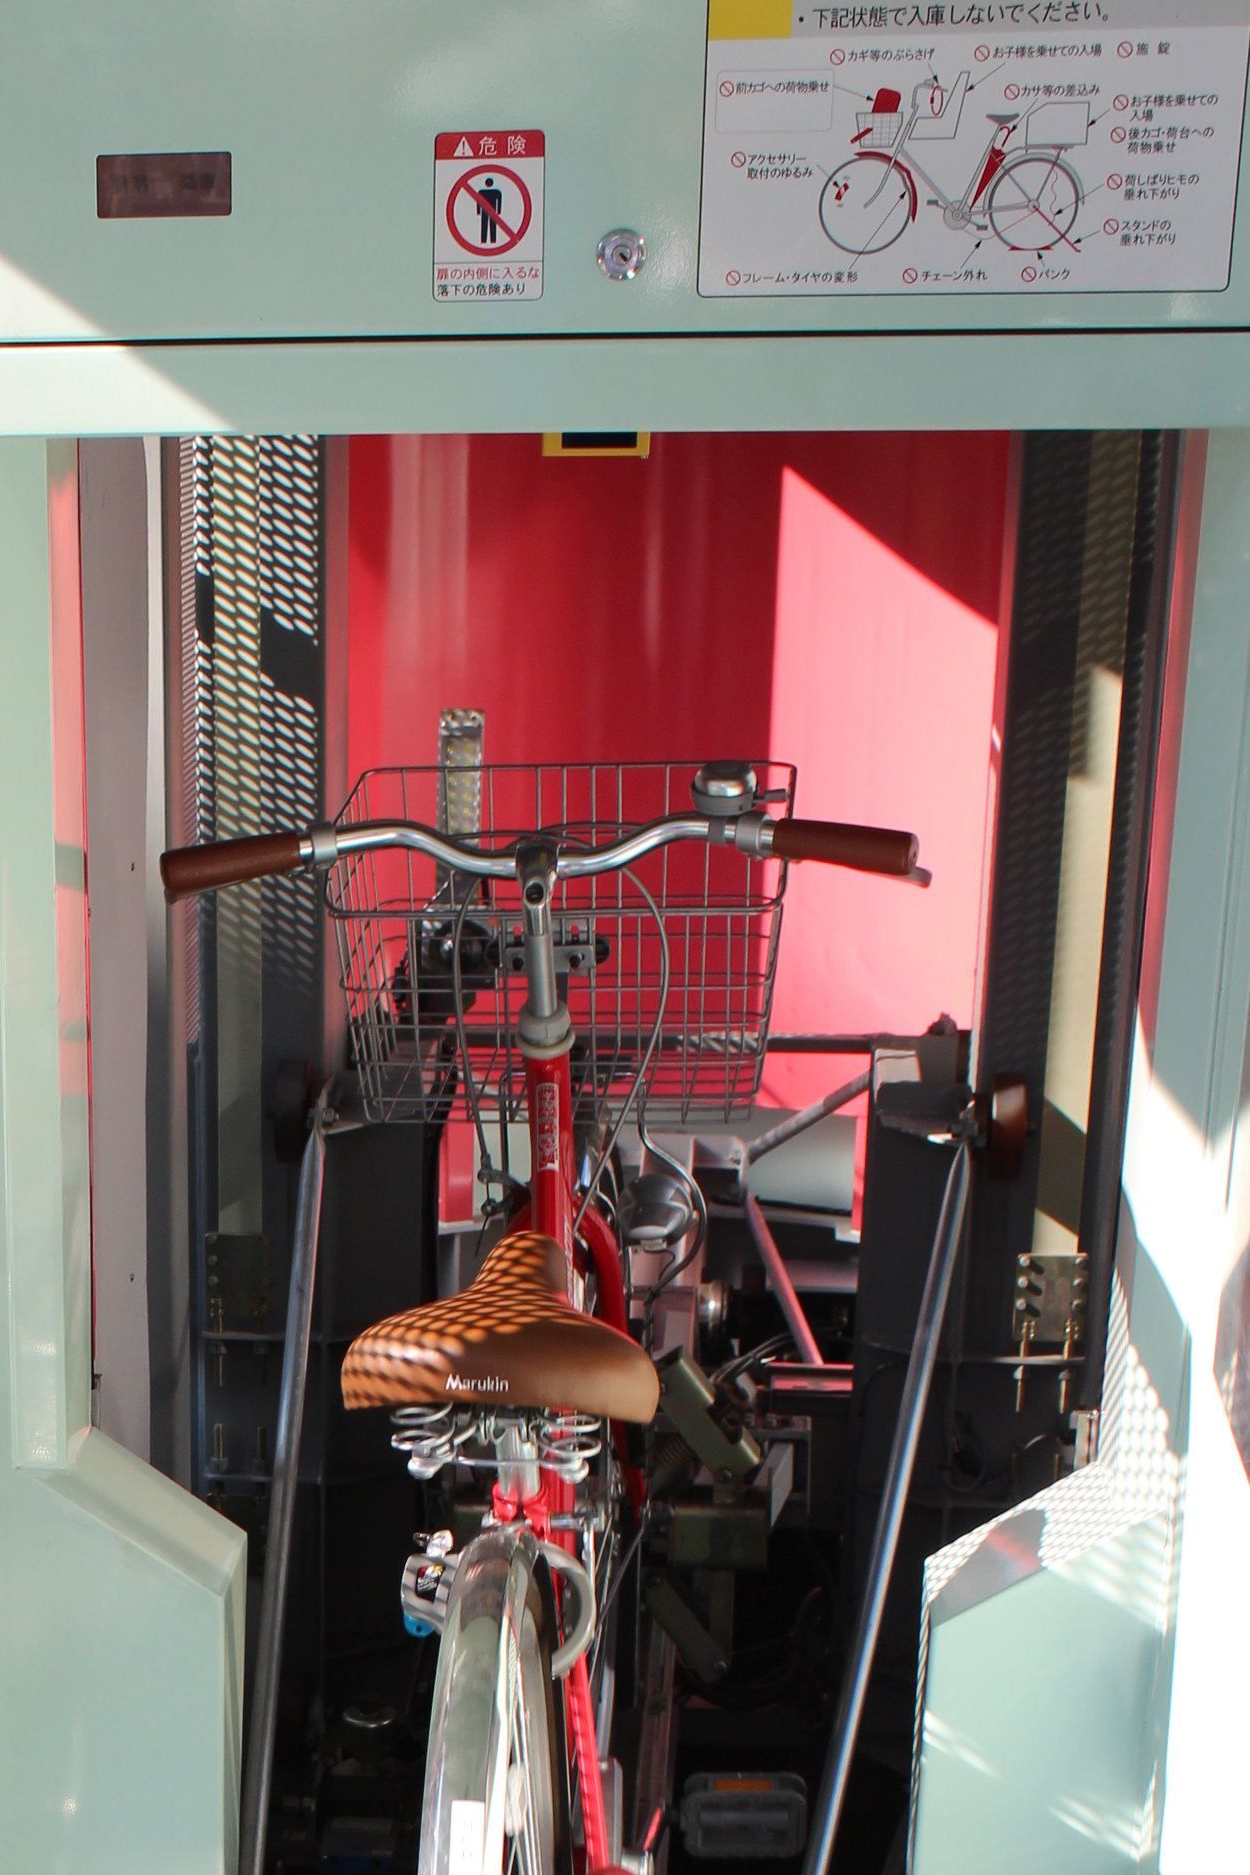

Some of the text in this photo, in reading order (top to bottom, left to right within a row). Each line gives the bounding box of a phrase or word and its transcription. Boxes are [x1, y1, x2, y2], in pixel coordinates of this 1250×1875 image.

[847, 47, 935, 62] カギ等のぶらさげ
[992, 44, 1102, 59] お子様を乗せての入場
[735, 80, 830, 95] 前カゴへの荷物乗せ
[1021, 83, 1100, 97] カサ等の差込み
[1130, 94, 1219, 108] お子様を乗せての
[1129, 109, 1154, 122] 入場
[1128, 127, 1215, 140] 後カゴ・荷台への
[1127, 141, 1176, 154] 荷物乗せ
[747, 153, 807, 166] アクセサリー
[746, 166, 813, 180] 取付のゆるみ
[1124, 173, 1200, 187] 荷しばりヒモの
[1123, 187, 1181, 201] 垂れ下がり
[1120, 219, 1172, 232] スタンドの
[1120, 233, 1176, 247] 垂れ下がり
[436, 266, 540, 281] 扉の内側に入るな
[743, 271, 858, 284] フレーム・タイヤの変形
[921, 269, 988, 282] チェーン外れ
[436, 282, 526, 297] 落下の危険あり
[445, 1374, 510, 1393] Marukin
